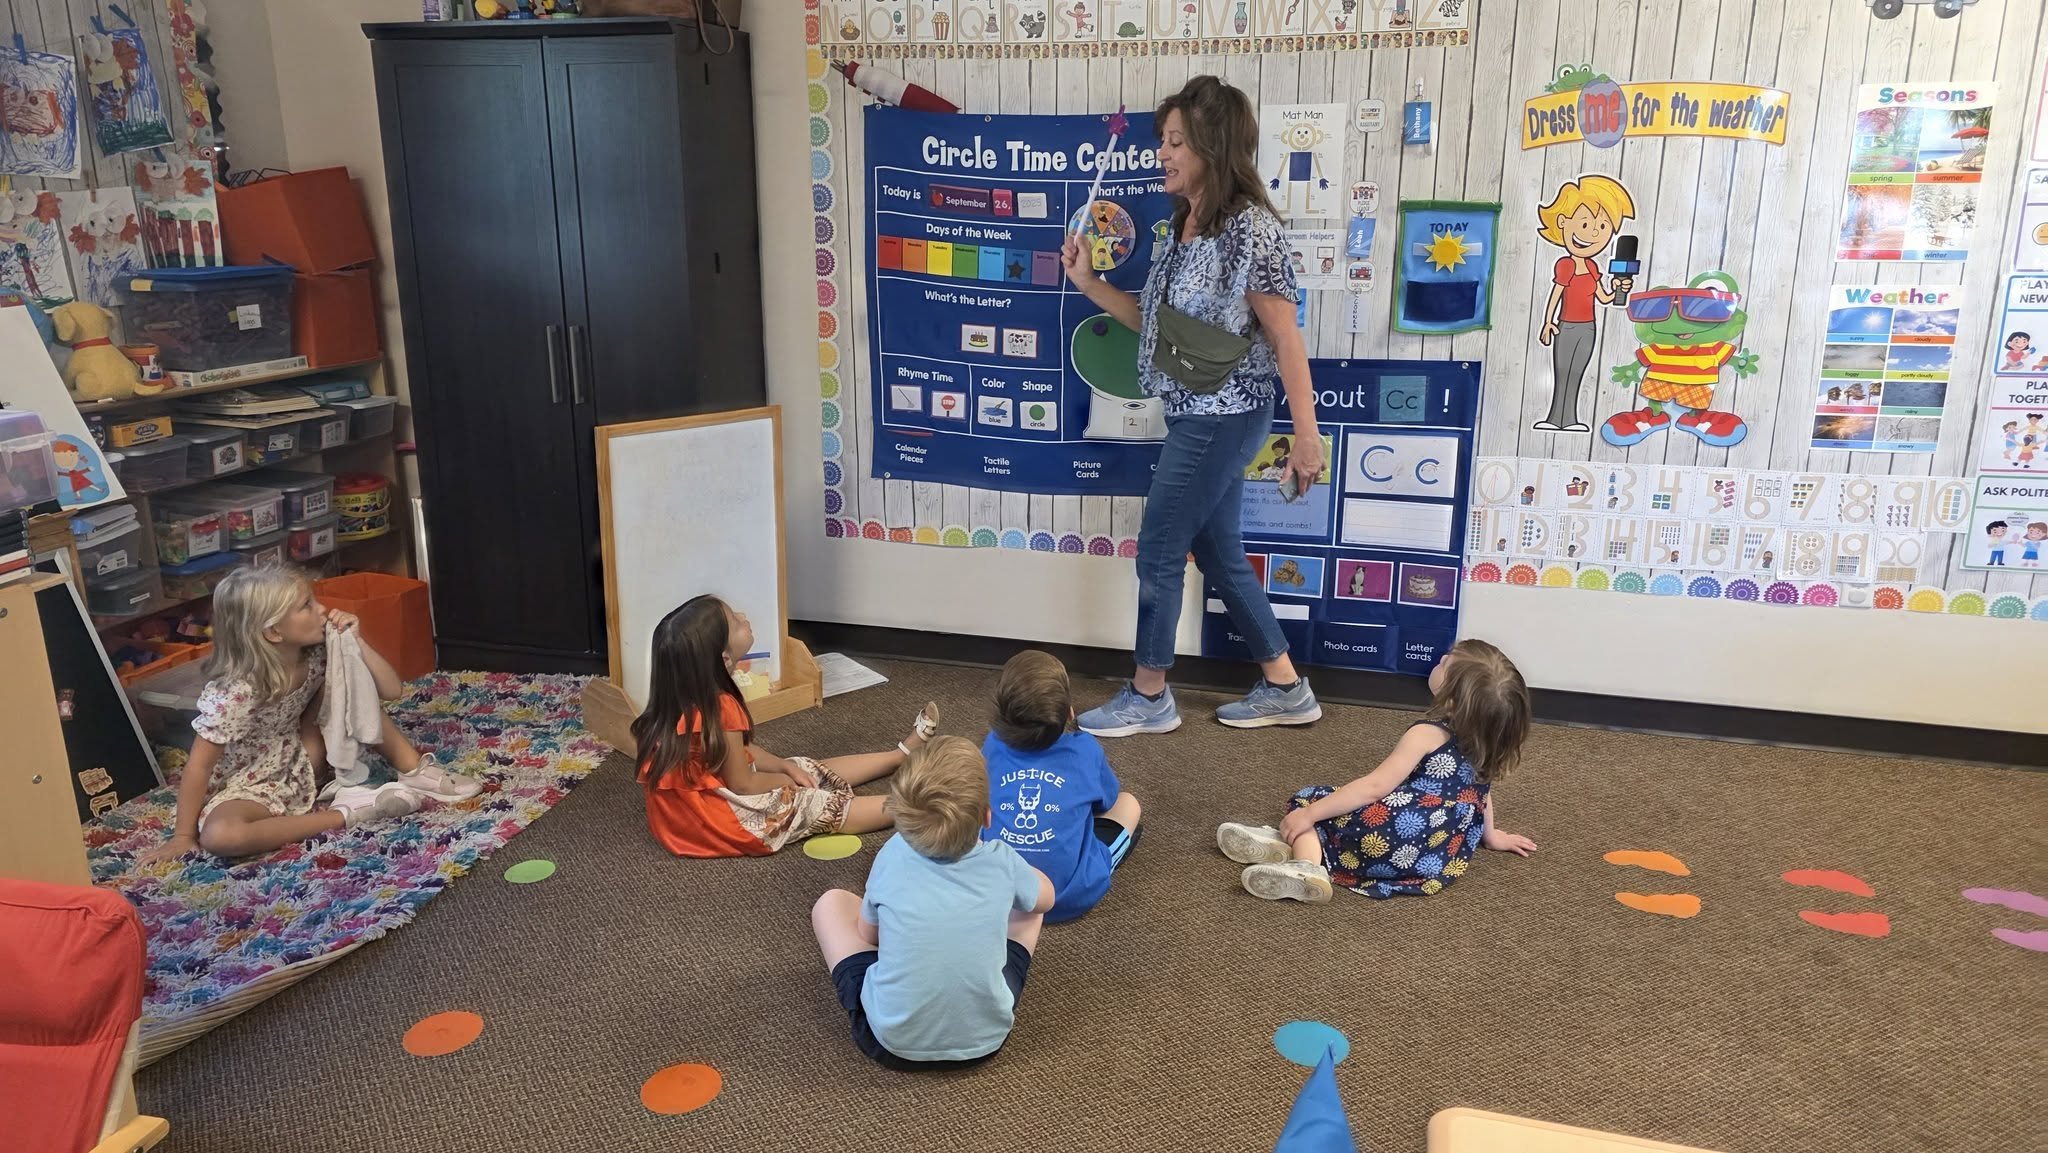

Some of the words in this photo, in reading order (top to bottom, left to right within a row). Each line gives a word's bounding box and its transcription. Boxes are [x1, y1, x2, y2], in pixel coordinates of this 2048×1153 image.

[1878, 87, 1978, 104] Seasons
[1283, 111, 1302, 120] Mat
[1305, 110, 1323, 120] Man
[1527, 103, 1575, 141] Dress
[1584, 90, 1621, 134] me
[1632, 92, 1660, 128] for
[1670, 91, 1700, 128] the
[1708, 95, 1785, 134] weather
[1413, 107, 1422, 139] Bethany
[922, 135, 997, 169] Circle
[1006, 140, 1067, 172] Time
[1869, 174, 1893, 183] spring
[1932, 174, 1964, 182] summer
[882, 185, 914, 200] Today
[914, 188, 921, 200] is
[1127, 184, 1144, 195] the
[945, 195, 987, 209] September
[926, 223, 950, 237] Days
[952, 227, 963, 237] of
[965, 228, 982, 238] the
[984, 229, 1012, 240] Week
[1429, 222, 1469, 233] TODAY
[1309, 232, 1336, 242] Helpers
[1924, 251, 1947, 259] winter
[925, 290, 958, 304] What's
[960, 293, 975, 306] the
[977, 296, 1011, 308] Letter?
[1845, 287, 1949, 305] Weather
[898, 367, 929, 381] Rhyme
[931, 371, 953, 383] Time
[981, 377, 1006, 389] Color
[1022, 381, 1053, 394] Shape
[1281, 385, 1365, 408] out
[1386, 389, 1418, 411] Cc
[2009, 394, 2048, 405] TOGET
[988, 416, 1002, 424] blue
[1129, 417, 1138, 427] 2
[895, 443, 927, 455] Calendar
[900, 453, 924, 464] Pieces
[983, 456, 1010, 466] Tactile
[1073, 460, 1102, 470] Picture
[1360, 445, 1394, 482] C
[983, 465, 1011, 475] Letters
[1076, 469, 1099, 479] Cards
[1477, 461, 1515, 504] 0
[1536, 463, 1544, 507] 1
[1567, 464, 1596, 510] 2
[1620, 467, 1637, 511] 3
[1658, 469, 1682, 513] 4
[1708, 473, 1733, 513] 5
[1744, 474, 1771, 520] 6
[1799, 476, 1826, 521] 7
[1983, 486, 2008, 496] ASK
[1842, 479, 1873, 524] 8
[1894, 481, 1924, 527] 9
[1926, 480, 1971, 528] 10
[1324, 641, 1350, 652] Photo
[1352, 643, 1378, 654] cards
[1406, 642, 1434, 654] Letter
[1406, 652, 1432, 662] cards
[1000, 768, 1066, 788] JUSTICE
[1000, 827, 1055, 845] RESCUE
